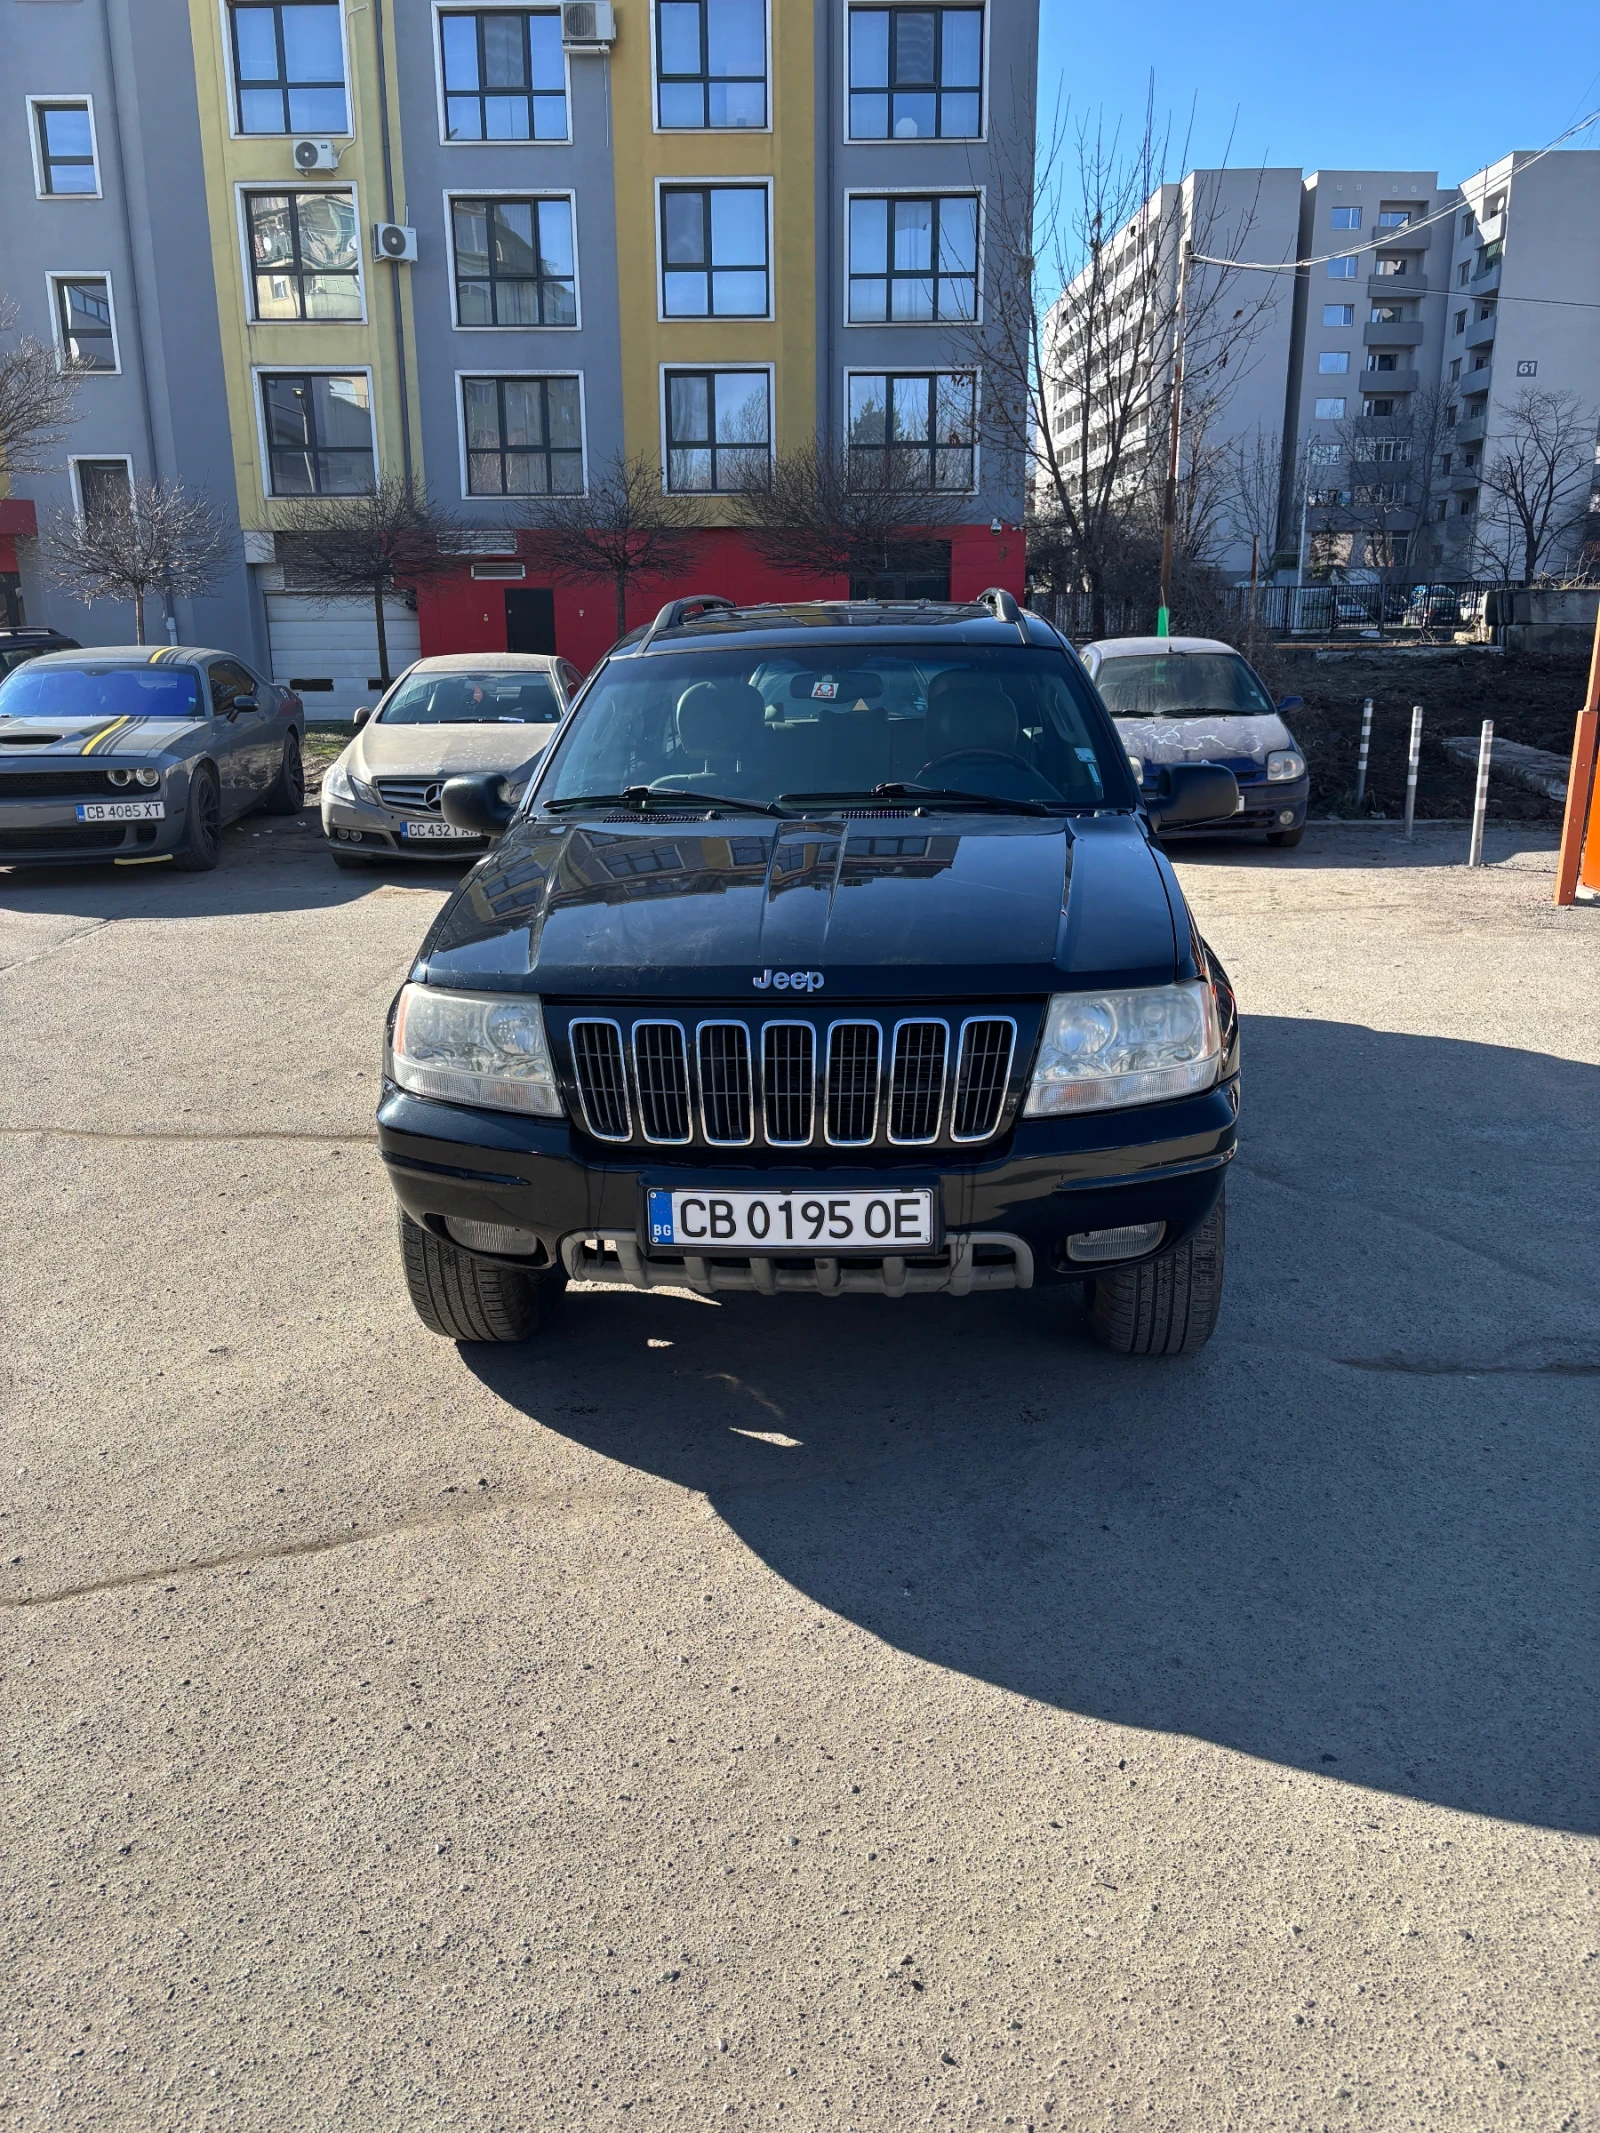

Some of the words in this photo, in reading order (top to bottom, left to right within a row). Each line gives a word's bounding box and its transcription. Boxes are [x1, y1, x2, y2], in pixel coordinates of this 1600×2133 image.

[1518, 362, 1536, 374] 61
[86, 805, 105, 819] CB
[108, 804, 141, 818] 4085
[143, 803, 161, 817] XT
[409, 824, 426, 837] CC
[427, 824, 458, 837] 4321
[753, 969, 825, 993] Jeep
[680, 1198, 737, 1239] CB
[747, 1200, 854, 1240] 0195
[864, 1198, 922, 1239] OE
[653, 1224, 672, 1236] BG
